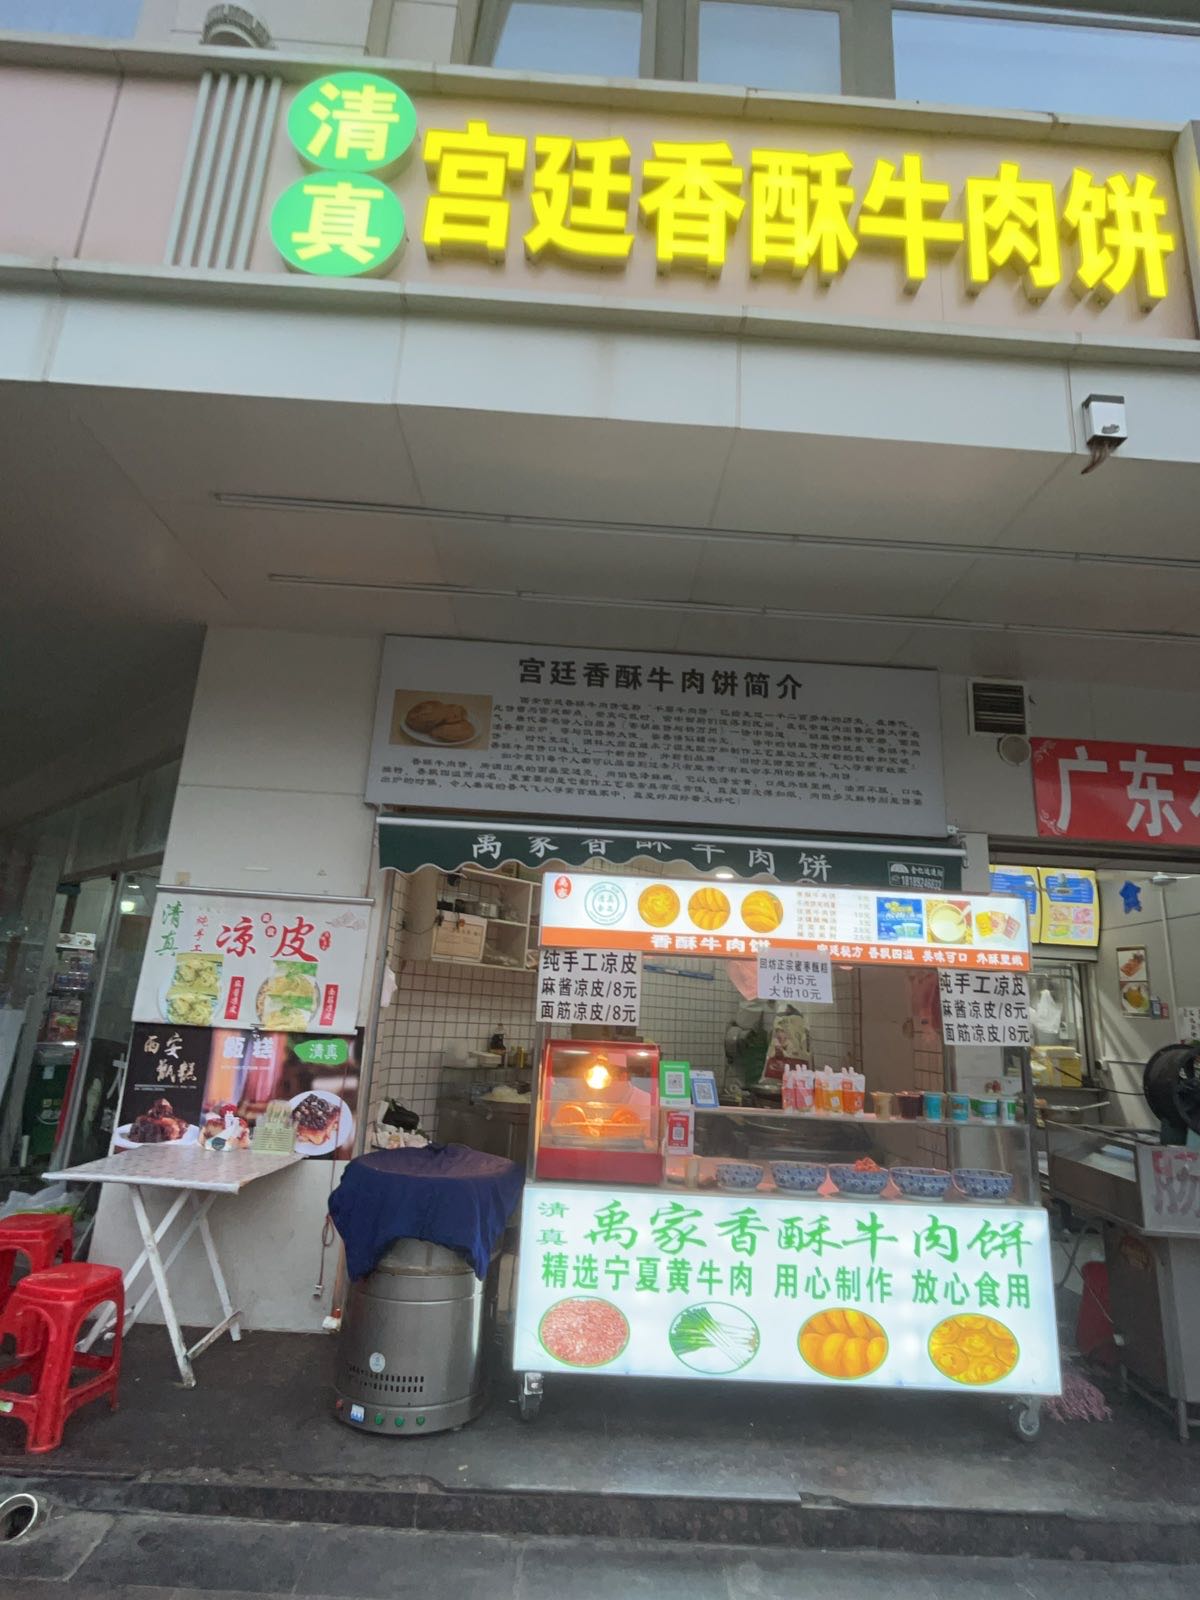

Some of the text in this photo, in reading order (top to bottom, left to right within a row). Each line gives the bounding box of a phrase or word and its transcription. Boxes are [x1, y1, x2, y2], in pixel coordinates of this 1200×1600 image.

[291, 83, 401, 265] 清真
[422, 119, 1175, 299] 宫廷香酥牛肉饼
[518, 657, 803, 701] 宫廷香酥牛肉饼简介
[1056, 745, 1200, 837] 广东
[154, 900, 184, 958] 清真
[216, 915, 320, 963] 凉皮
[650, 934, 771, 954] 香酥牛肉饼
[543, 949, 637, 975] 纯手工凉皮
[922, 949, 968, 964] 美味可口
[976, 952, 1024, 966] 外酥里嫩
[541, 977, 637, 999] 麻酱凉皮/8元
[773, 972, 817, 986] 小份5元
[940, 972, 1026, 996] 纯手工凉皮
[769, 986, 822, 1000] 大份10元
[540, 1000, 637, 1023] 面筋凉皮/8元
[942, 999, 1028, 1020] 麻酱凉皮/8元
[144, 1031, 183, 1059] 西安
[944, 1022, 1031, 1043] 面筋凉皮/8元
[308, 1043, 339, 1060] 清真
[536, 1201, 570, 1247] 清真
[583, 1199, 1033, 1267] 禹家香酥牛肉饼
[541, 1251, 1031, 1309] 精选宁夏黄牛肉 用心制作 放心食用
